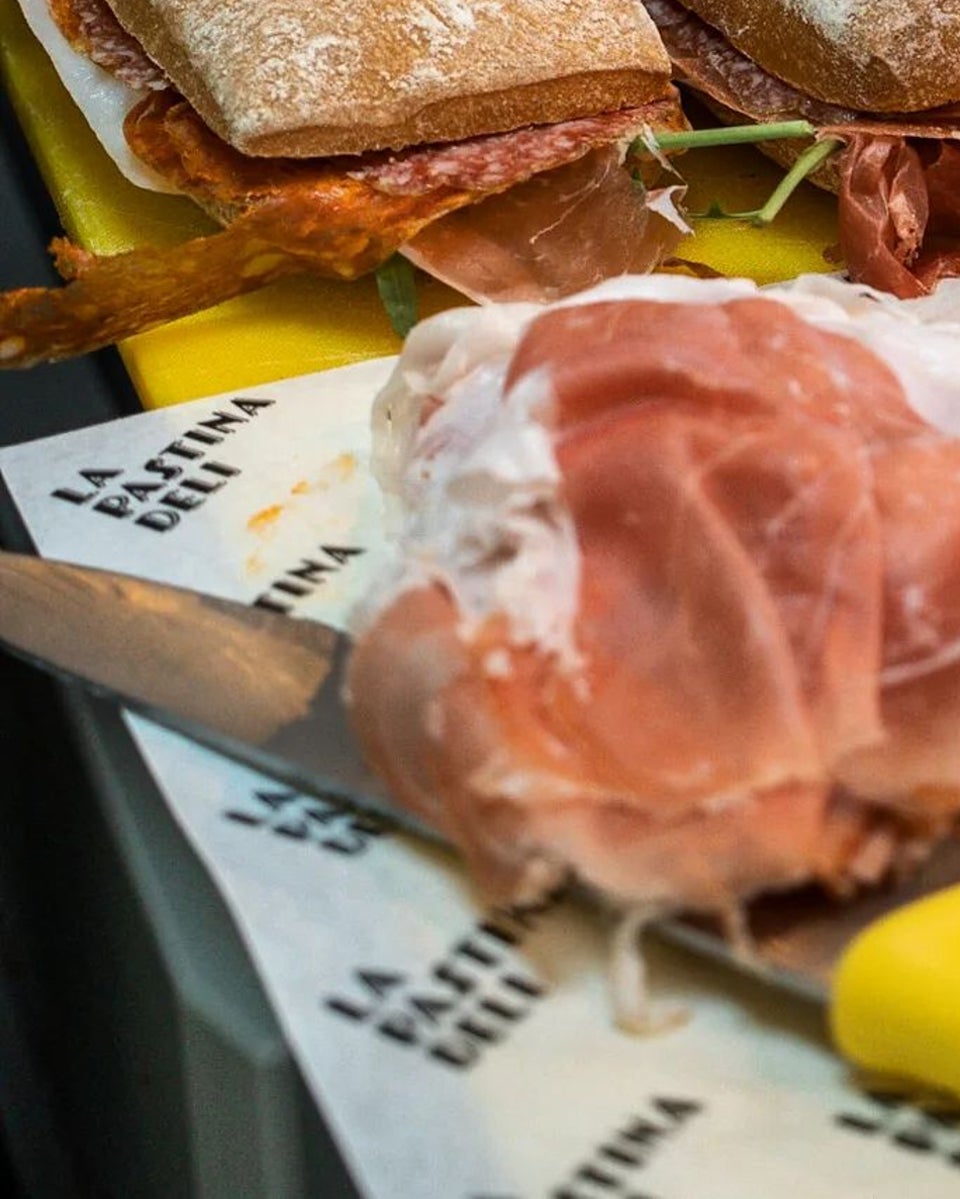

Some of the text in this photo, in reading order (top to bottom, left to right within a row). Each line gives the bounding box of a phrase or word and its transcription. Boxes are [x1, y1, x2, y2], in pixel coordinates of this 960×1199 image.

[51, 468, 124, 506] LA
[93, 397, 277, 520] PASTINA
[134, 461, 242, 532] DELI
[253, 545, 368, 615] TINA
